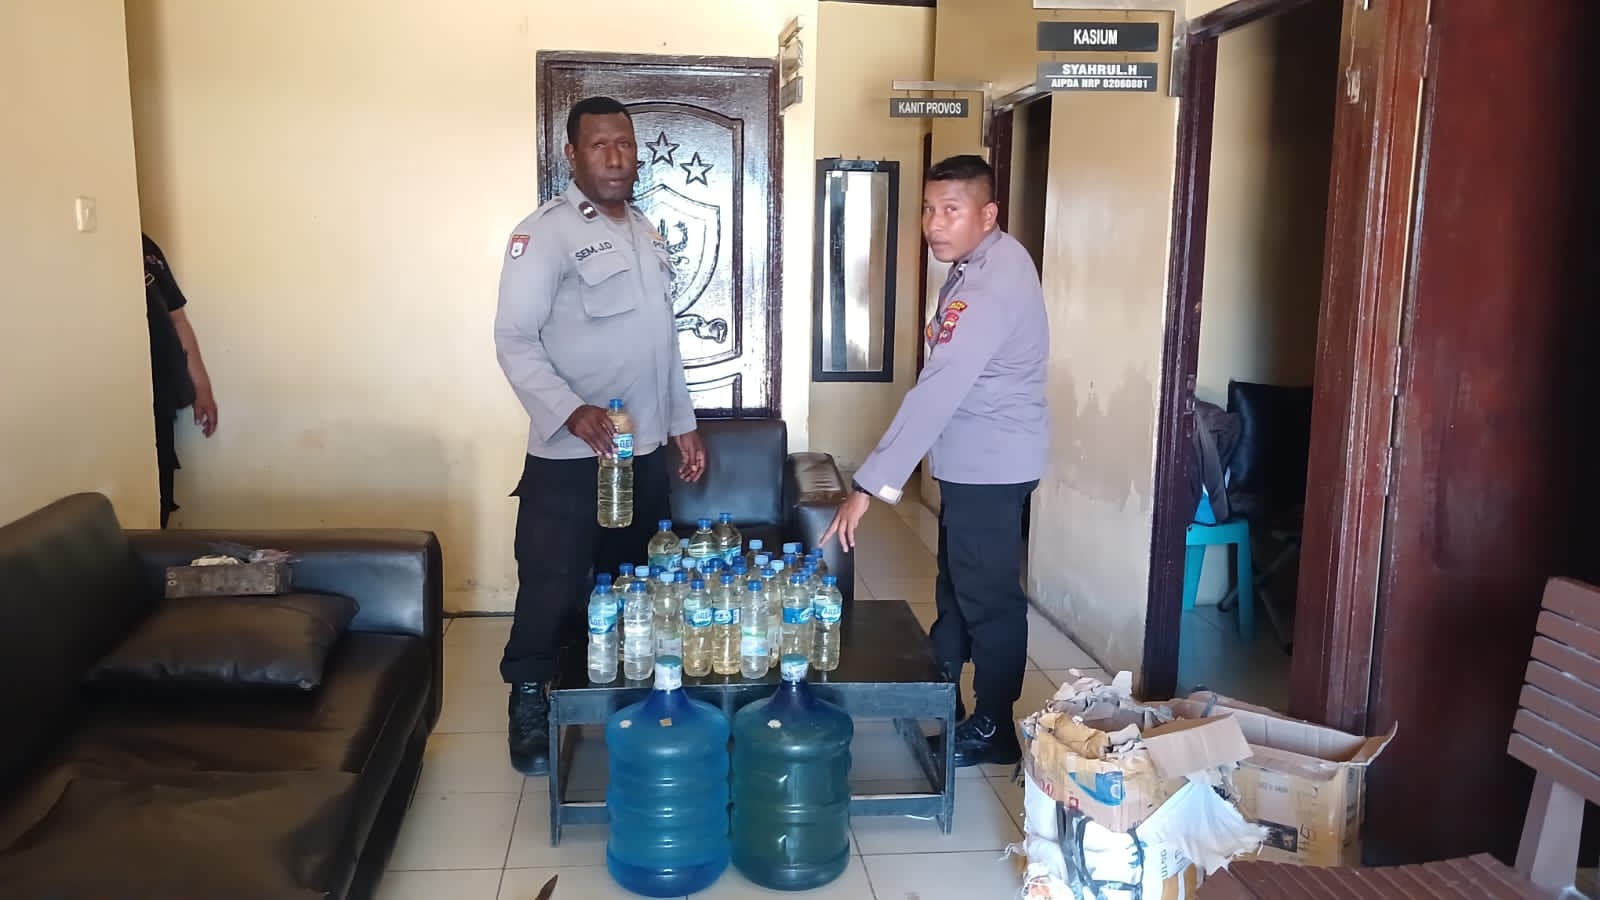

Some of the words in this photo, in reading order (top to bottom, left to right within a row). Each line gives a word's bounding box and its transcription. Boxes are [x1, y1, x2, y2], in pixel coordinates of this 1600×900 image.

[1073, 29, 1118, 45] KASIUM
[1062, 64, 1137, 75] SYAHRUL.H
[1051, 79, 1079, 89] AIPDA
[898, 101, 925, 114] KANIT
[926, 102, 962, 114] PROVOS
